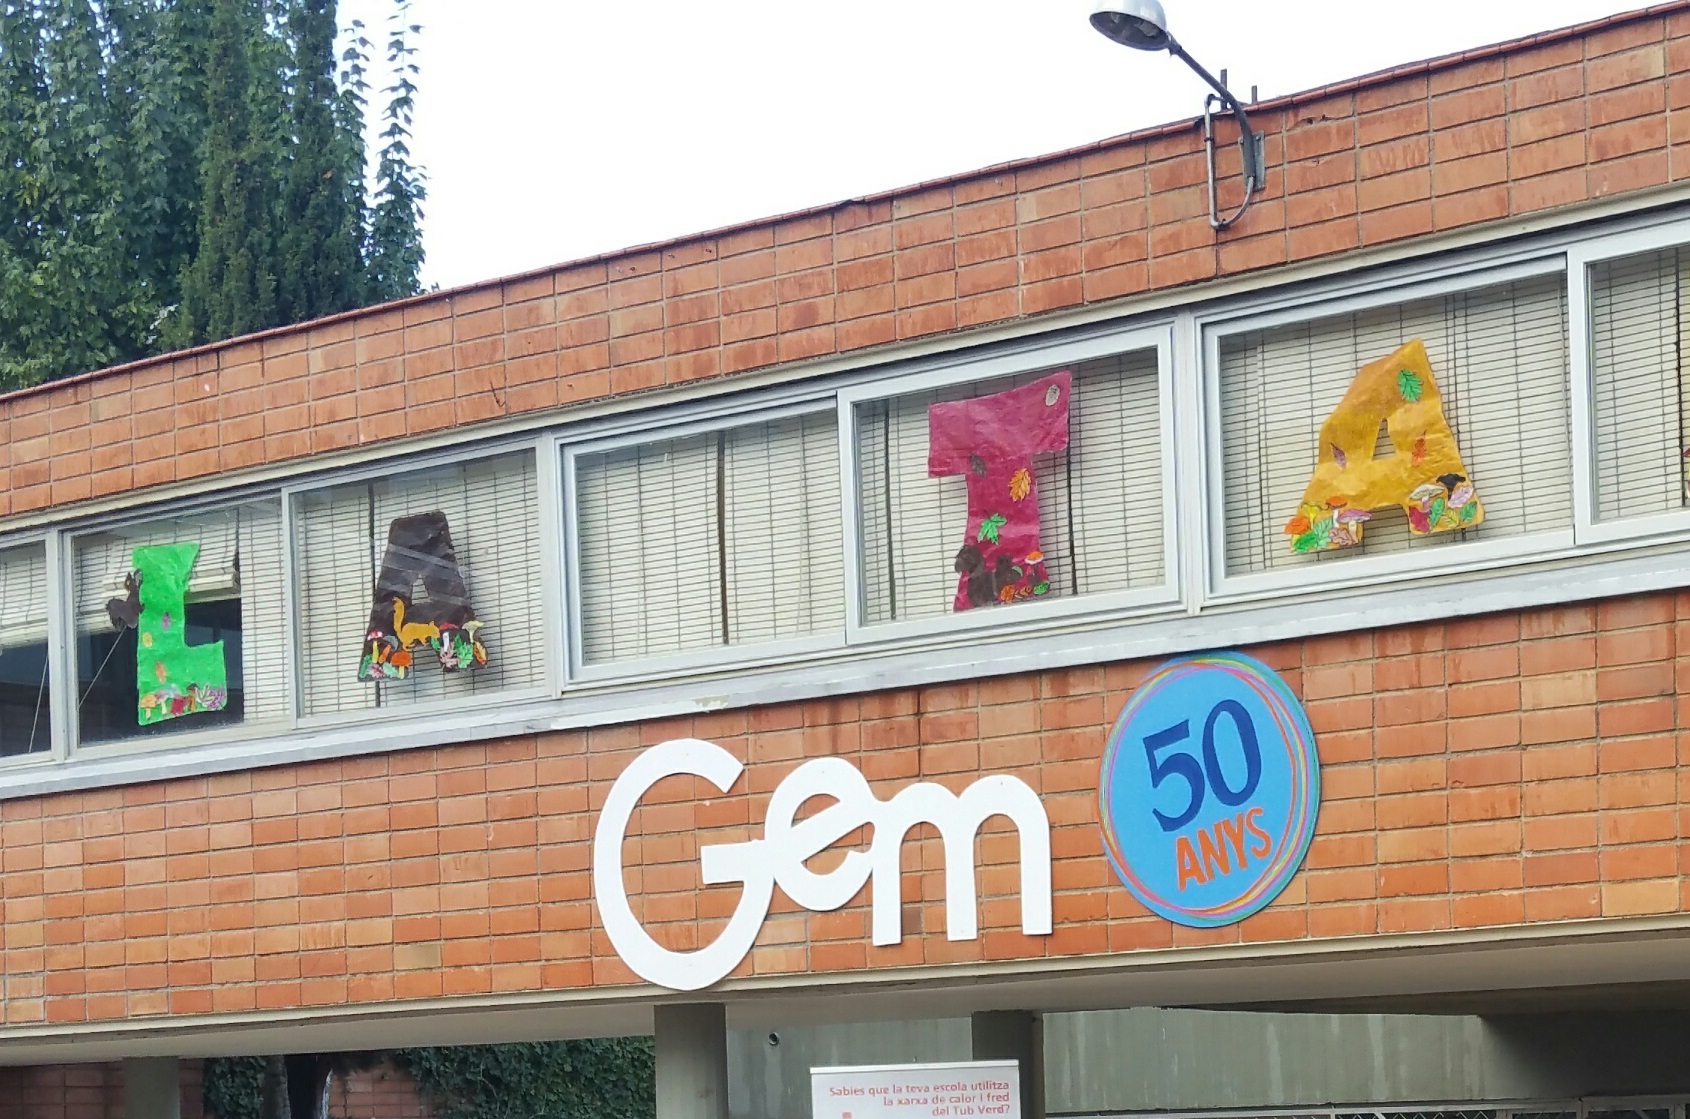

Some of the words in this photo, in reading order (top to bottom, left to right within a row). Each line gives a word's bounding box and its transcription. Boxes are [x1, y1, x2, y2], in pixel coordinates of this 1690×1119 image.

[1142, 699, 1264, 833] 50
[593, 738, 1052, 991] Gem
[1175, 807, 1273, 892] ANYS
[829, 1085, 865, 1096] Sabies
[868, 1087, 889, 1097] que
[892, 1084, 902, 1094] la
[933, 1081, 967, 1092] escola
[970, 1080, 1010, 1091] utilitza
[883, 1096, 894, 1106] la
[931, 1094, 946, 1105] de
[949, 1092, 977, 1104] calor
[986, 1091, 1010, 1102] fred
[932, 1106, 950, 1117] del
[953, 1105, 975, 1116] Tub
[977, 1104, 1011, 1115] Verd?
